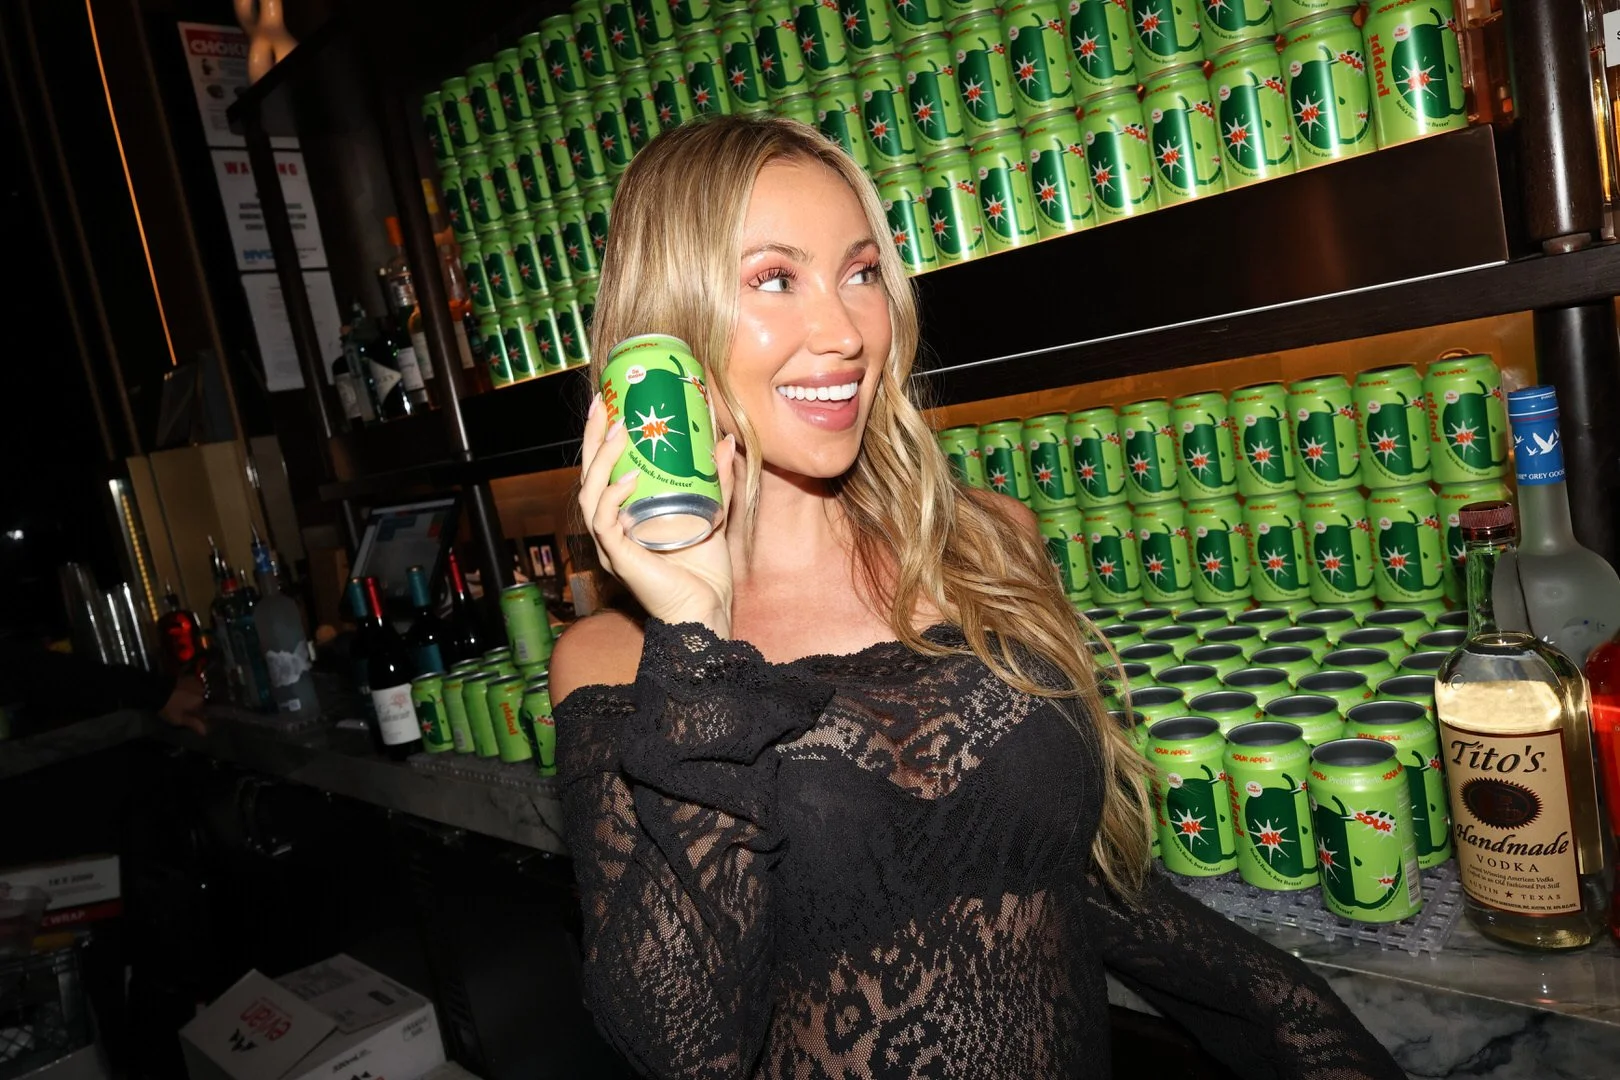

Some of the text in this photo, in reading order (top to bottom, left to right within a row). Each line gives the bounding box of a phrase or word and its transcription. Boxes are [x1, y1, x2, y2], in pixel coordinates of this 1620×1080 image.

[190, 39, 249, 57] CHOK
[1369, 33, 1390, 97] poppi
[1265, 79, 1286, 94] SOU
[224, 162, 298, 175] WANG
[642, 421, 669, 439] ZING
[641, 464, 656, 479] Back,
[656, 475, 668, 484] but
[670, 479, 692, 488] Better
[1528, 472, 1548, 480] GREY
[1451, 740, 1545, 773] Tito's
[1181, 821, 1202, 834] ZING
[1355, 812, 1392, 833] SOUR
[1260, 829, 1283, 845] ZING
[1456, 823, 1569, 856] Handmade
[1476, 854, 1539, 873] VODKA
[1470, 880, 1499, 895] AUSTIN
[1507, 875, 1535, 883] American
[1507, 881, 1535, 889] Fashioned
